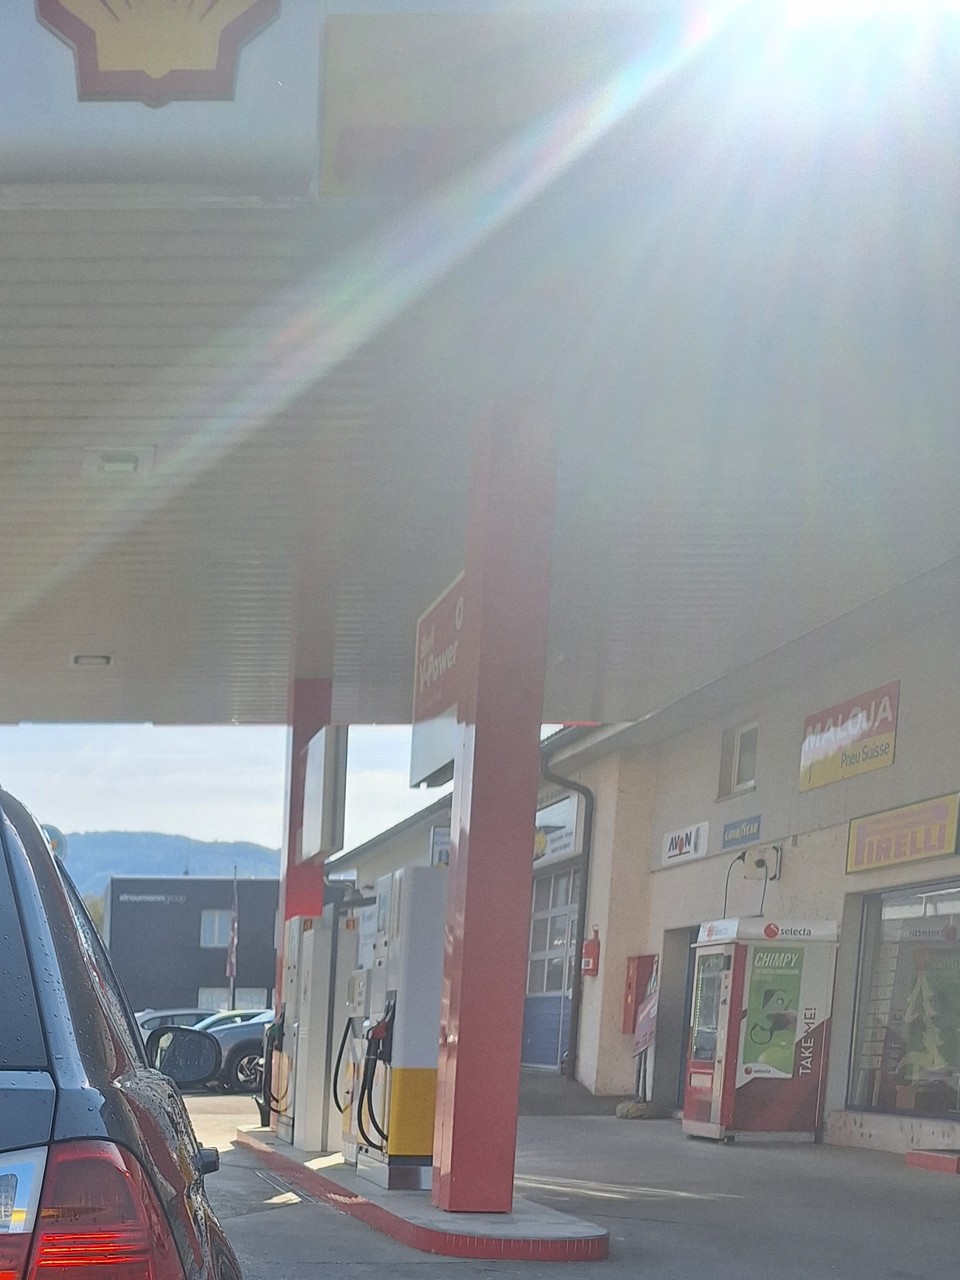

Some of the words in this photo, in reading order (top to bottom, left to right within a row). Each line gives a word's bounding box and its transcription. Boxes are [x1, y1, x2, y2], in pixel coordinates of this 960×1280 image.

[805, 694, 893, 751] MALOJA
[841, 750, 861, 769] Pneu
[862, 742, 890, 762] Suisse
[668, 831, 693, 854] AVON
[780, 927, 812, 937] selecta
[754, 952, 799, 968] CHIMPY
[804, 1007, 817, 1034] ME!
[799, 1038, 814, 1077] TAKE
